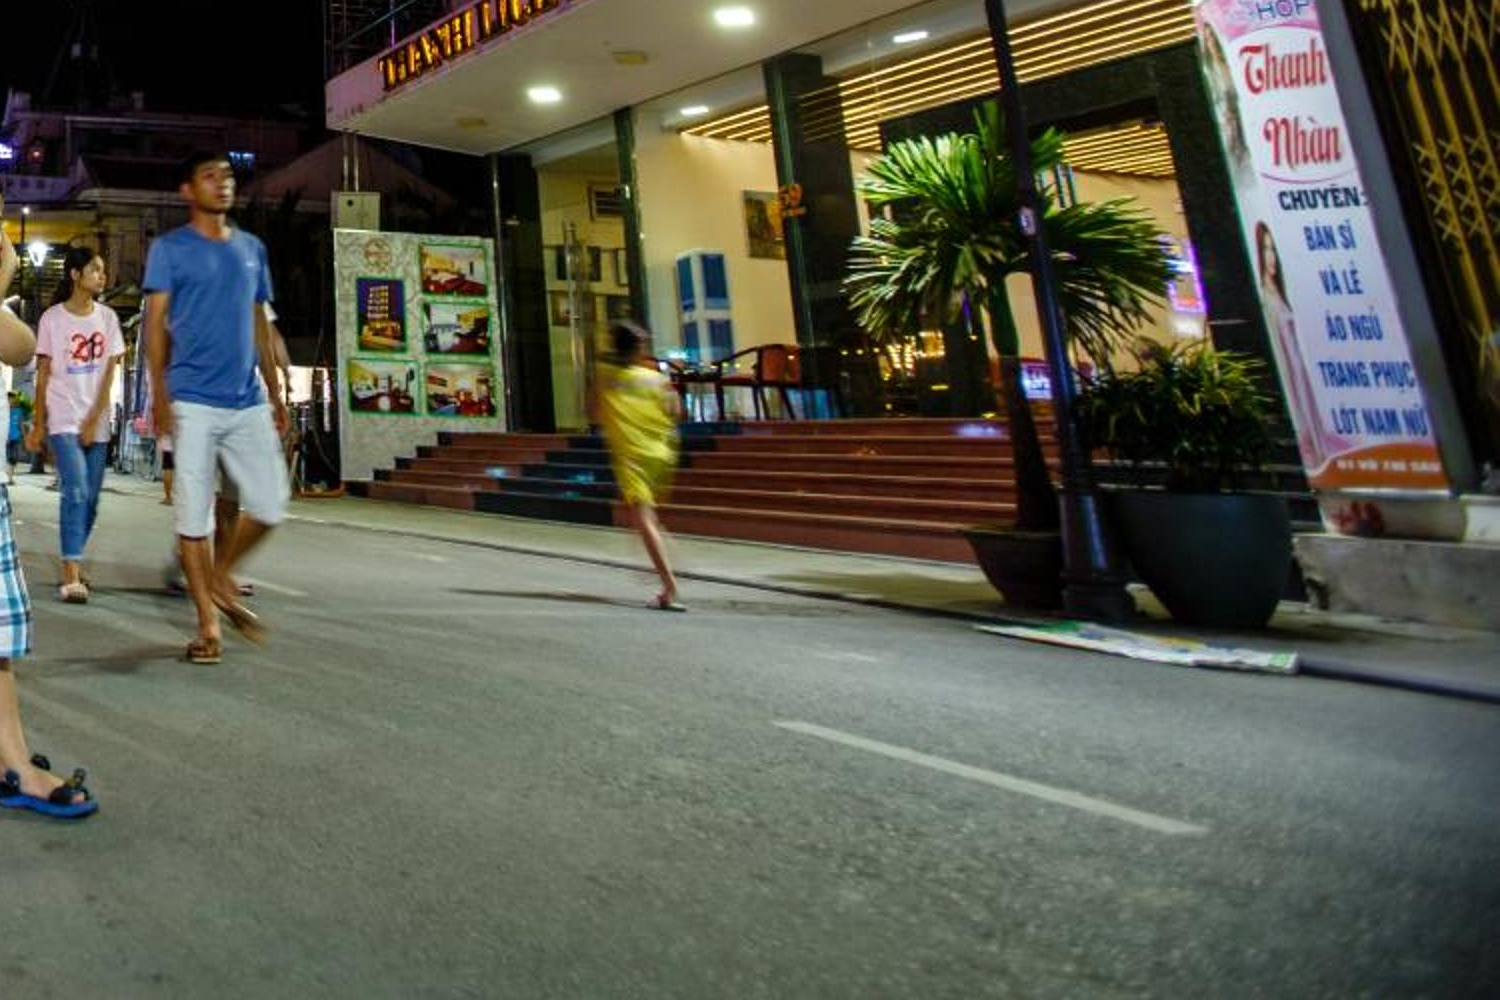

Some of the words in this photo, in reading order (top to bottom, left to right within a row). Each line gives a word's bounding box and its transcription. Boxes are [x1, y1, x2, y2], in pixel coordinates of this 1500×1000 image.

[1239, 38, 1327, 94] Thanh
[1263, 116, 1341, 170] Nhàn
[1317, 361, 1369, 388] TRANG
[1361, 407, 1402, 435] NAM
